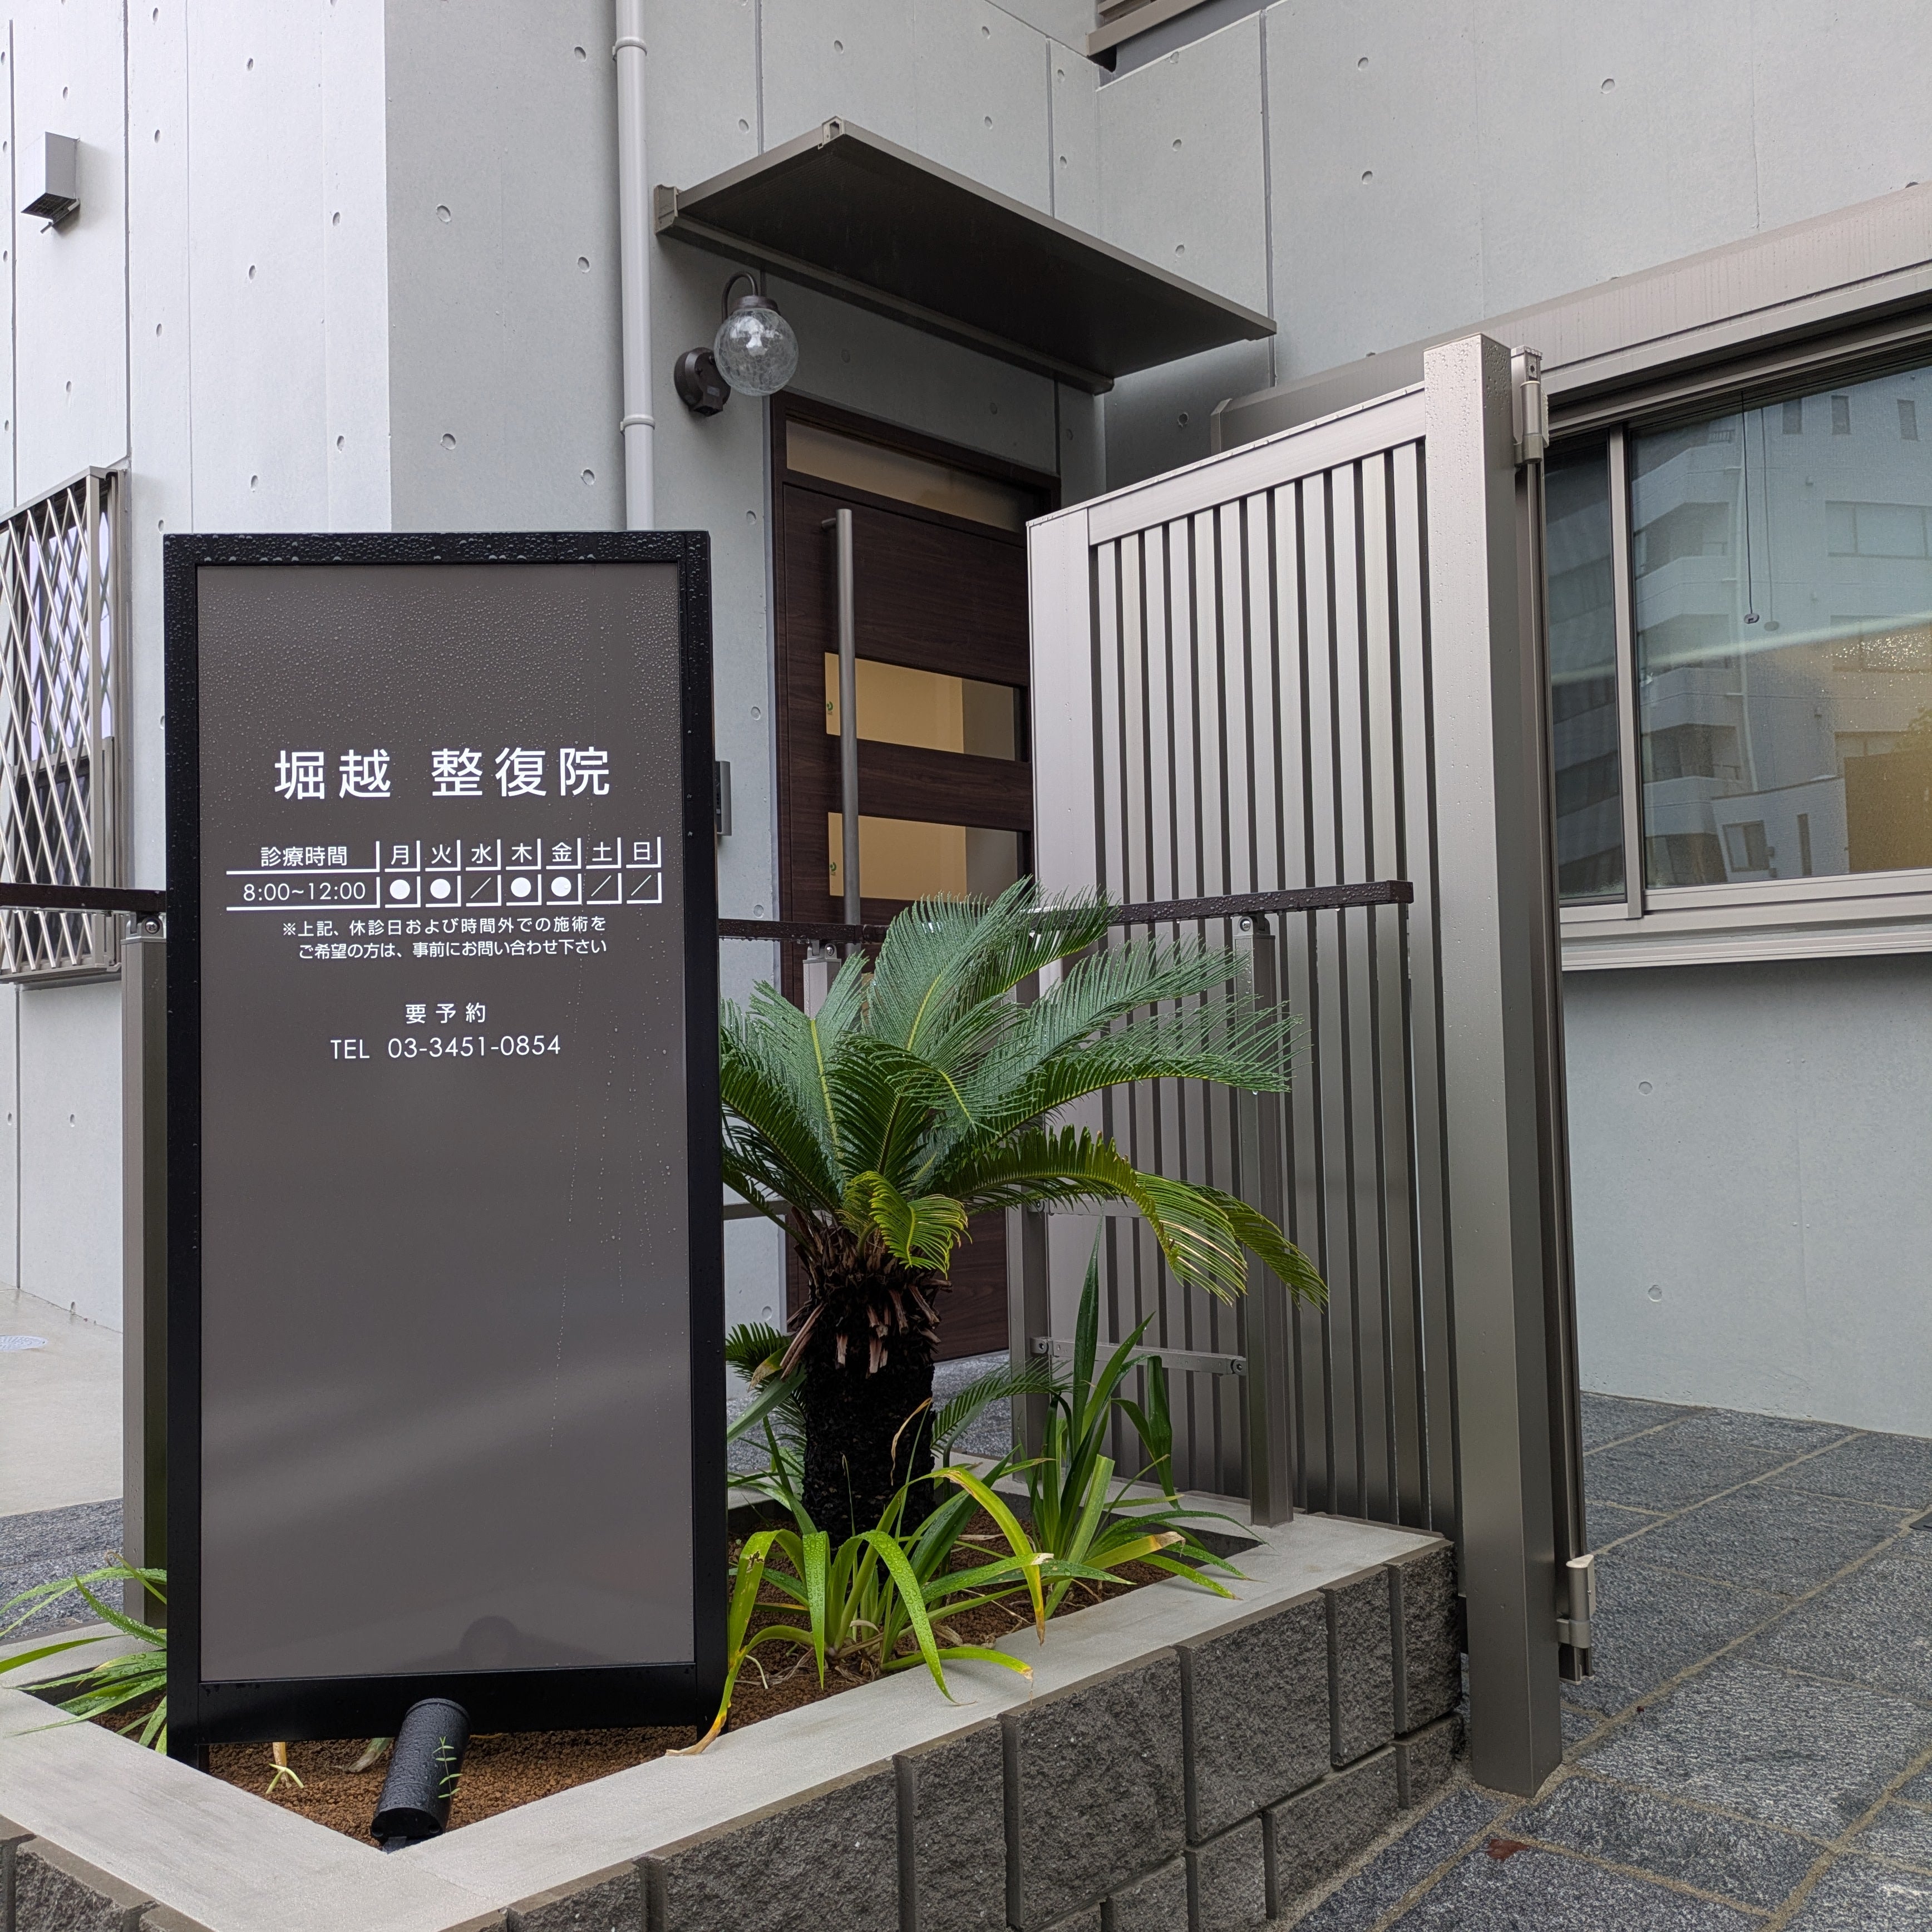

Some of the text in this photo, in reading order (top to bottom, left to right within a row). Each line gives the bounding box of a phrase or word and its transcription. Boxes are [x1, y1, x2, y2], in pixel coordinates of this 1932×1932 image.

[274, 746, 610, 800] 堀越 整復院
[260, 841, 650, 867] 診療時間 月 火 水 木 金 土 日
[299, 939, 607, 960] ご希望の方は、事前にお問い合わせ下さい
[405, 1002, 485, 1024] 要予約
[330, 1034, 561, 1059] TEL 03-3451-0854
